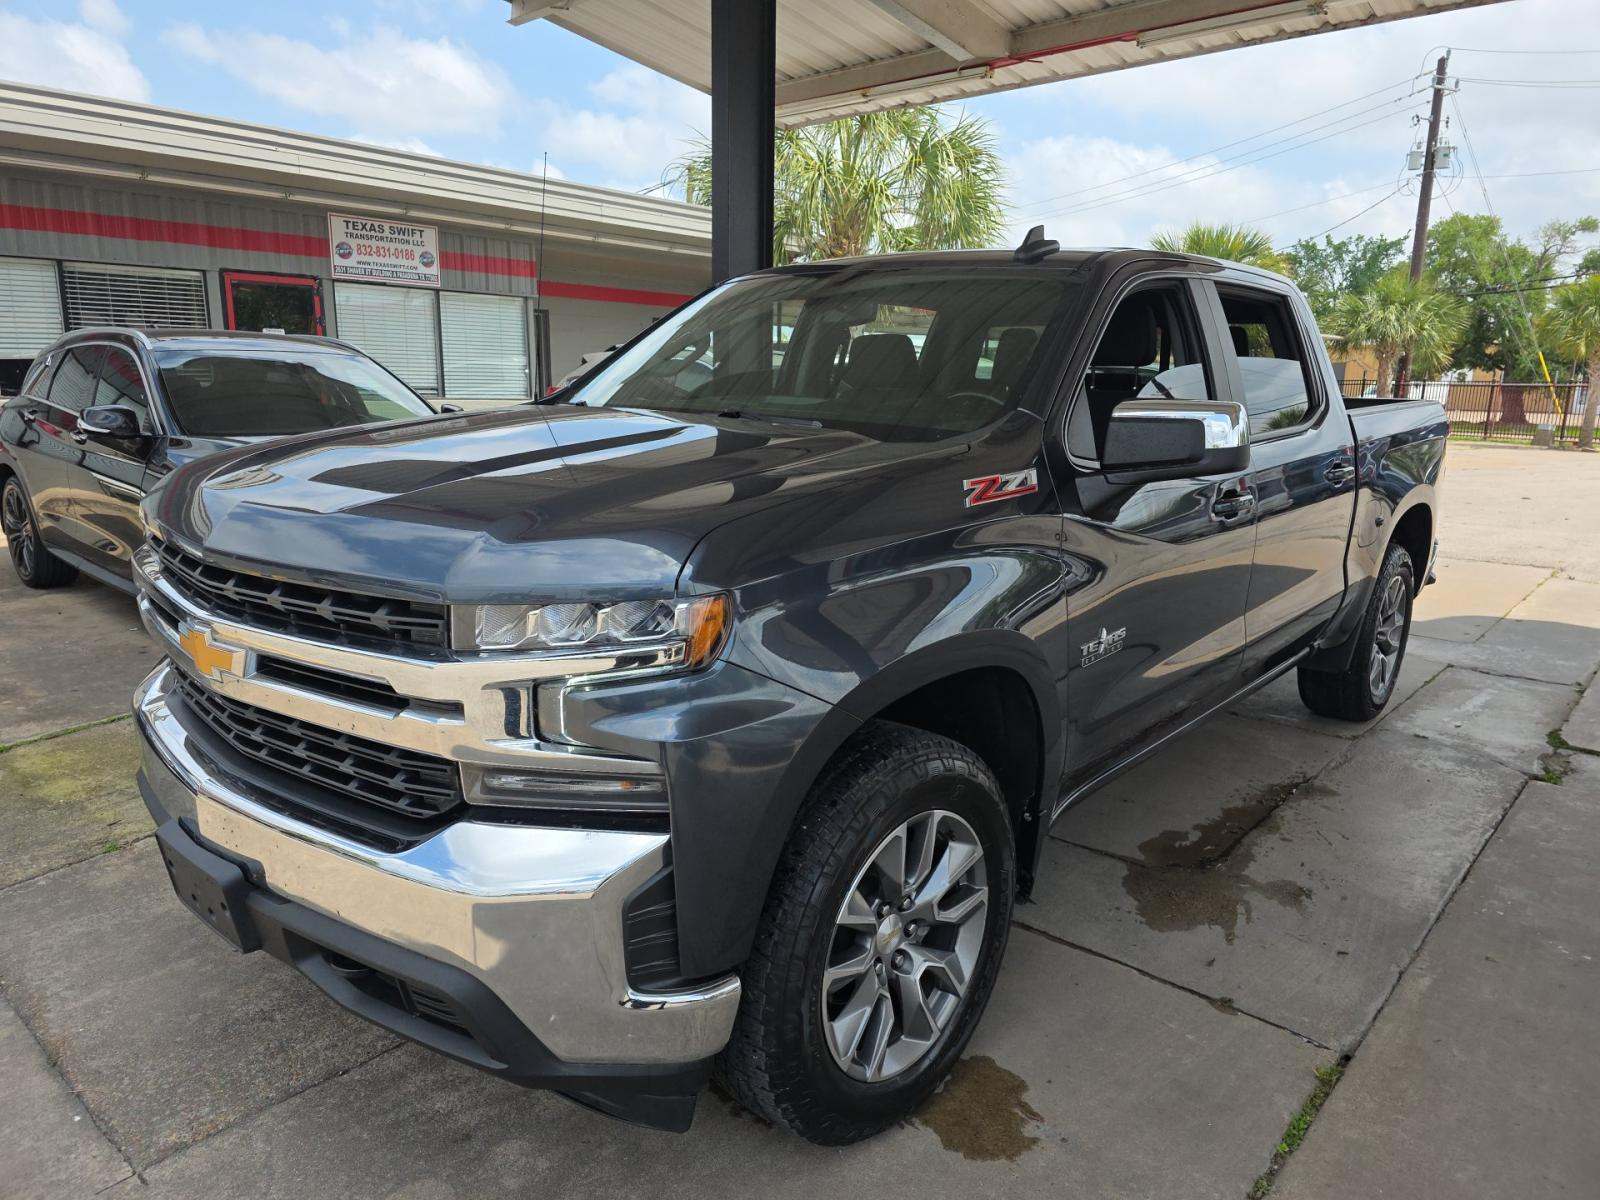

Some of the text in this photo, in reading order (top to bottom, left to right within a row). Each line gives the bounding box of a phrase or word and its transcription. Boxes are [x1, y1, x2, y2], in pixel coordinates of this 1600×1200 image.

[343, 220, 425, 239] TEXAS SWIFT
[344, 231, 411, 245] TRANSPORTATION
[356, 243, 415, 261] 832-831-0186
[963, 468, 1038, 508] Z71
[1081, 627, 1126, 656] TEXAS
